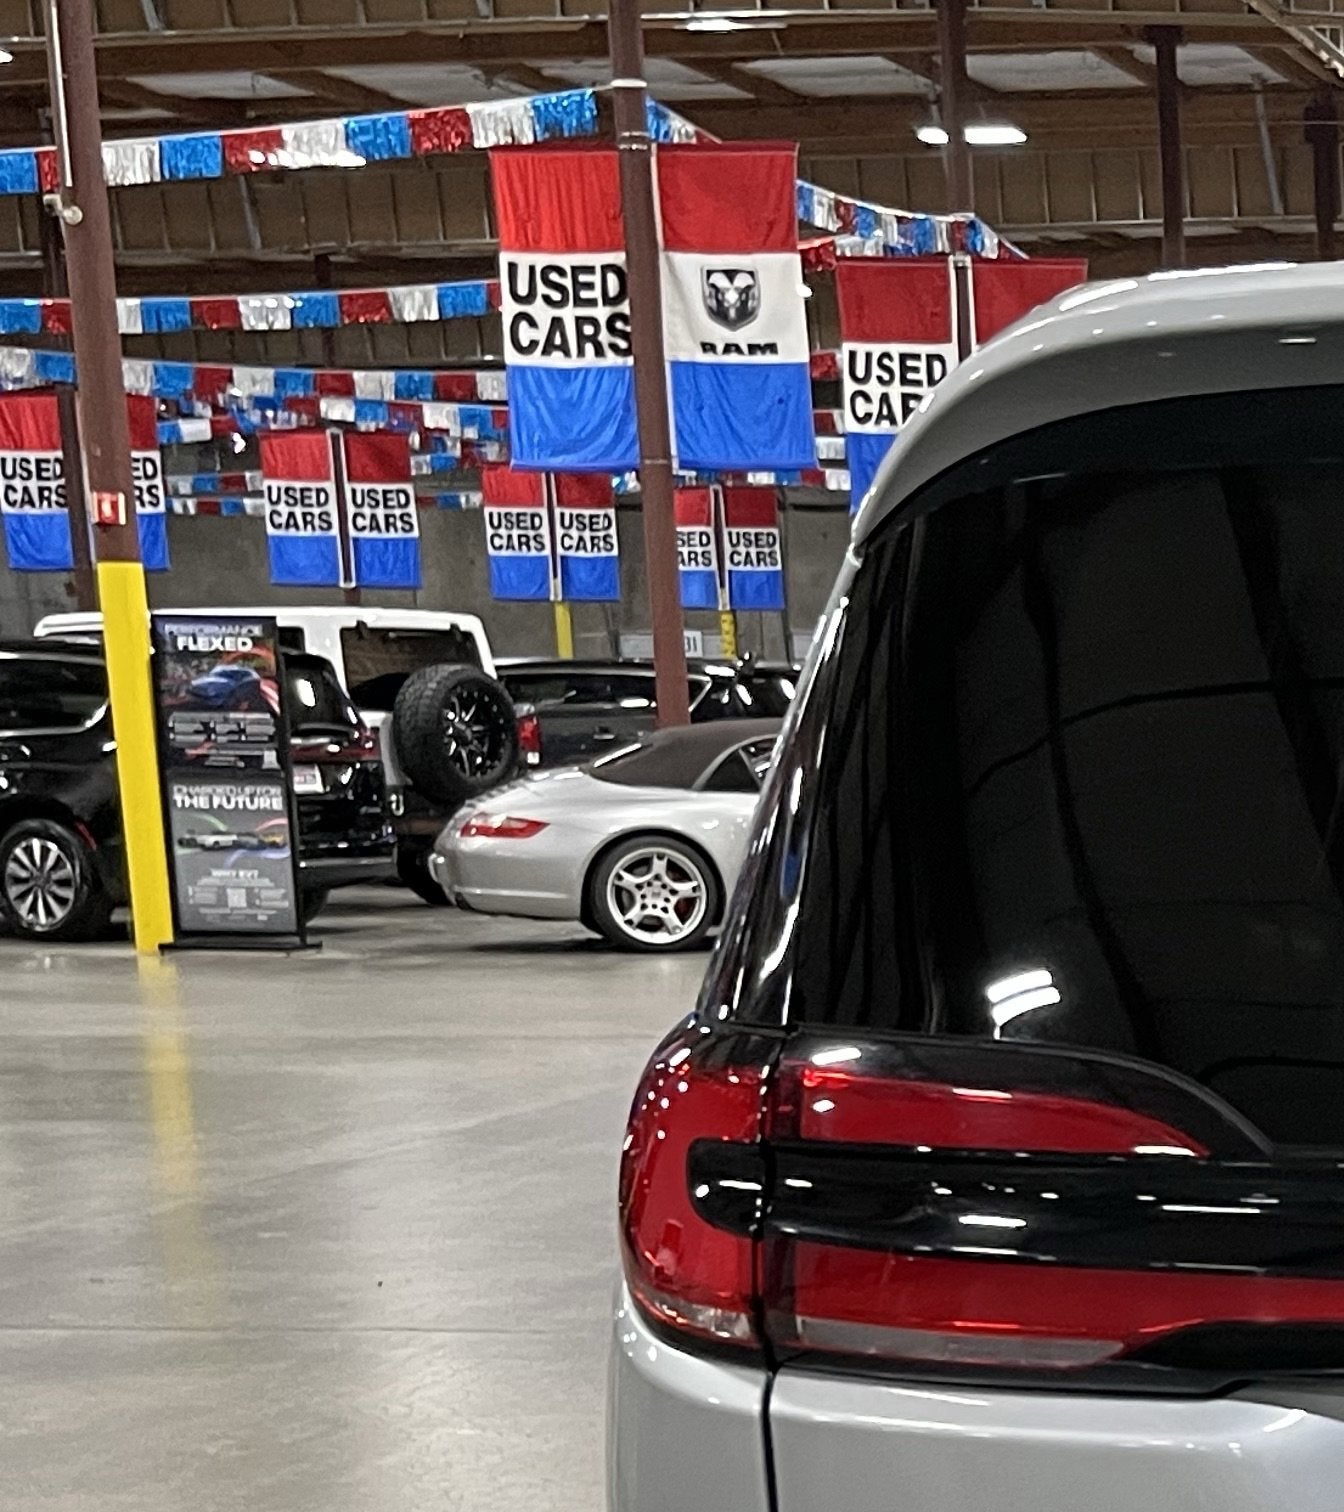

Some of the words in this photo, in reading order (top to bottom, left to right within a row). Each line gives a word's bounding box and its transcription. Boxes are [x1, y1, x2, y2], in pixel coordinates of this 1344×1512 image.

[507, 261, 630, 309] USED
[509, 311, 634, 359] CARS
[699, 341, 779, 356] RAM
[848, 349, 948, 388] USED
[1, 456, 64, 481] USED
[3, 484, 67, 509] CARS
[266, 485, 330, 508] USED
[350, 487, 411, 510] USED
[268, 510, 333, 532] CARS
[352, 511, 415, 534] CARS
[488, 511, 543, 531] USED
[559, 511, 613, 532] USED
[489, 533, 546, 553] CARS
[560, 533, 614, 554] CARS
[677, 531, 711, 548] SED
[728, 531, 777, 548] USED
[679, 550, 713, 567] ARS
[729, 550, 779, 567] CARS
[176, 636, 254, 651] FLEXED
[174, 795, 209, 809] THE
[212, 796, 283, 811] FUTURE
